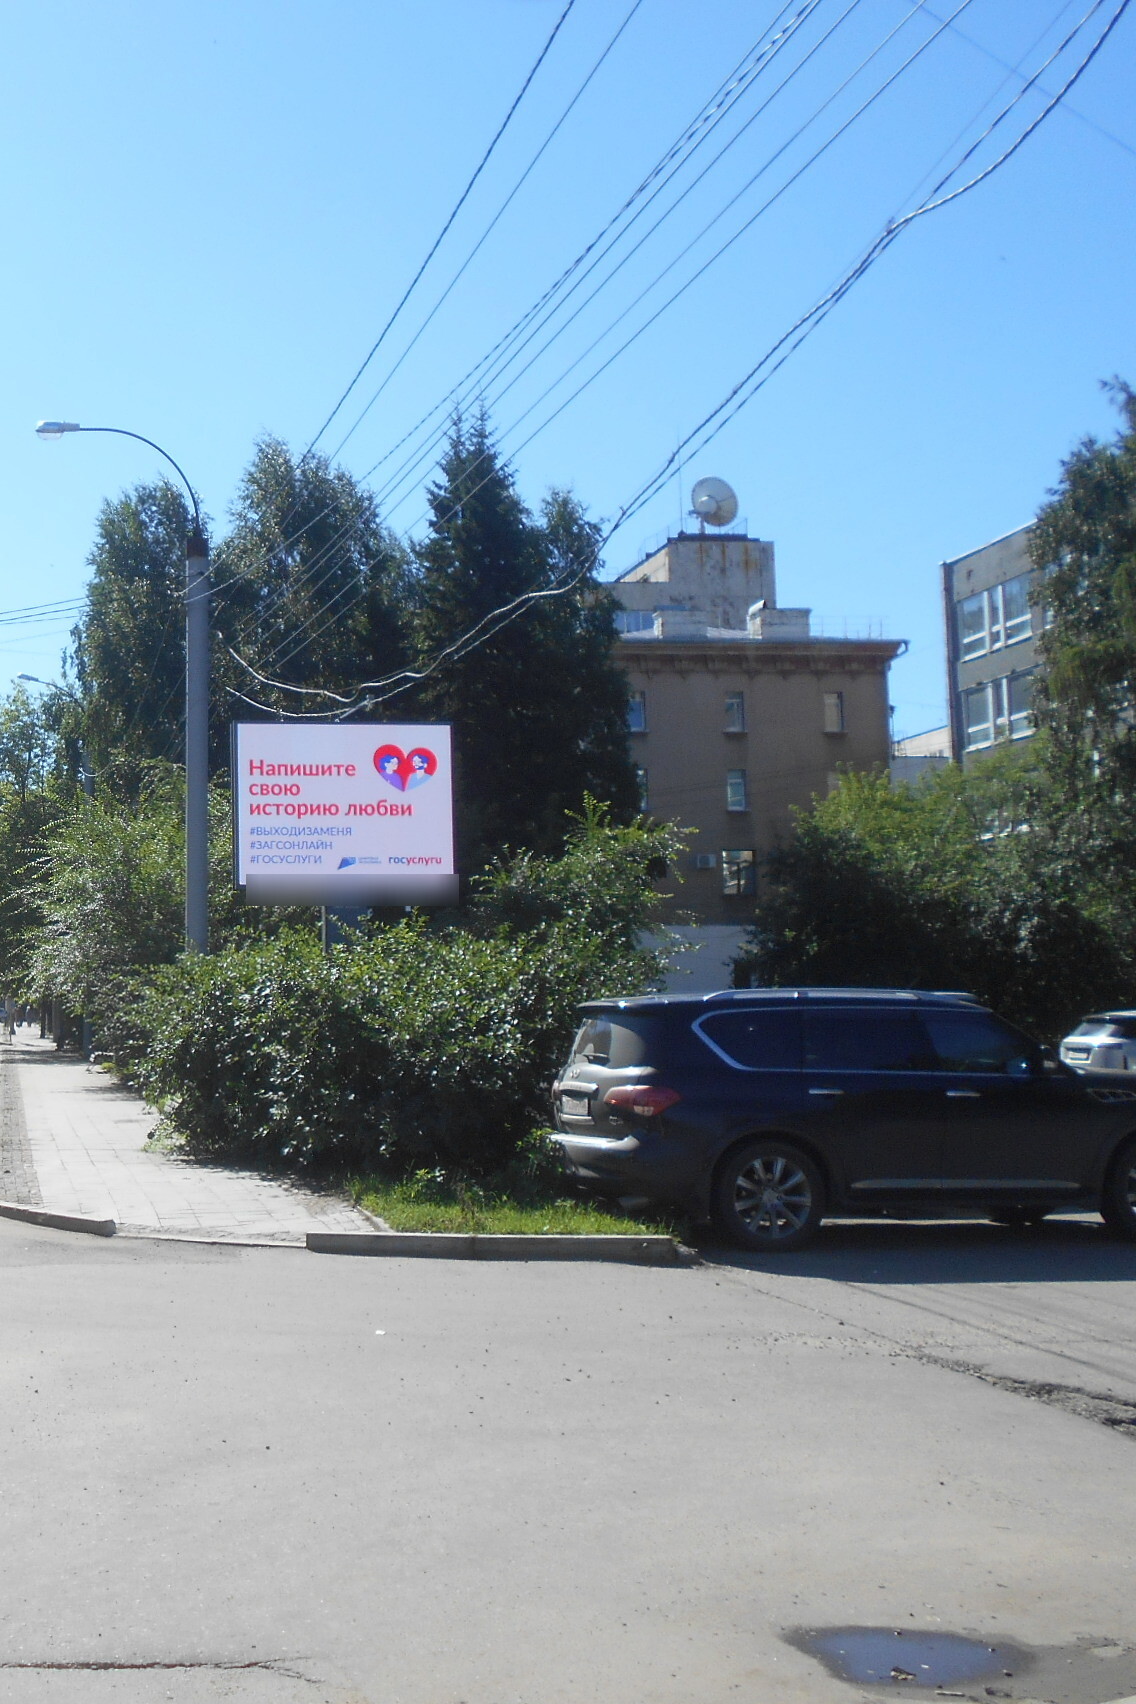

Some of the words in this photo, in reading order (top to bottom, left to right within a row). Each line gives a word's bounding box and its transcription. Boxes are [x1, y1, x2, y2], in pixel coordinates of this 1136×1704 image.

[249, 759, 356, 777] Напишите
[249, 782, 301, 796] свою
[249, 802, 340, 820] историю
[344, 799, 413, 817] любви
[250, 826, 353, 837] #ВЫХОДИЗАМЕНЯ
[250, 838, 333, 850] #ЗАГСОНЛАЙН
[250, 854, 323, 865] #ГОСУСЛУГИ
[388, 855, 443, 866] госуслуги
